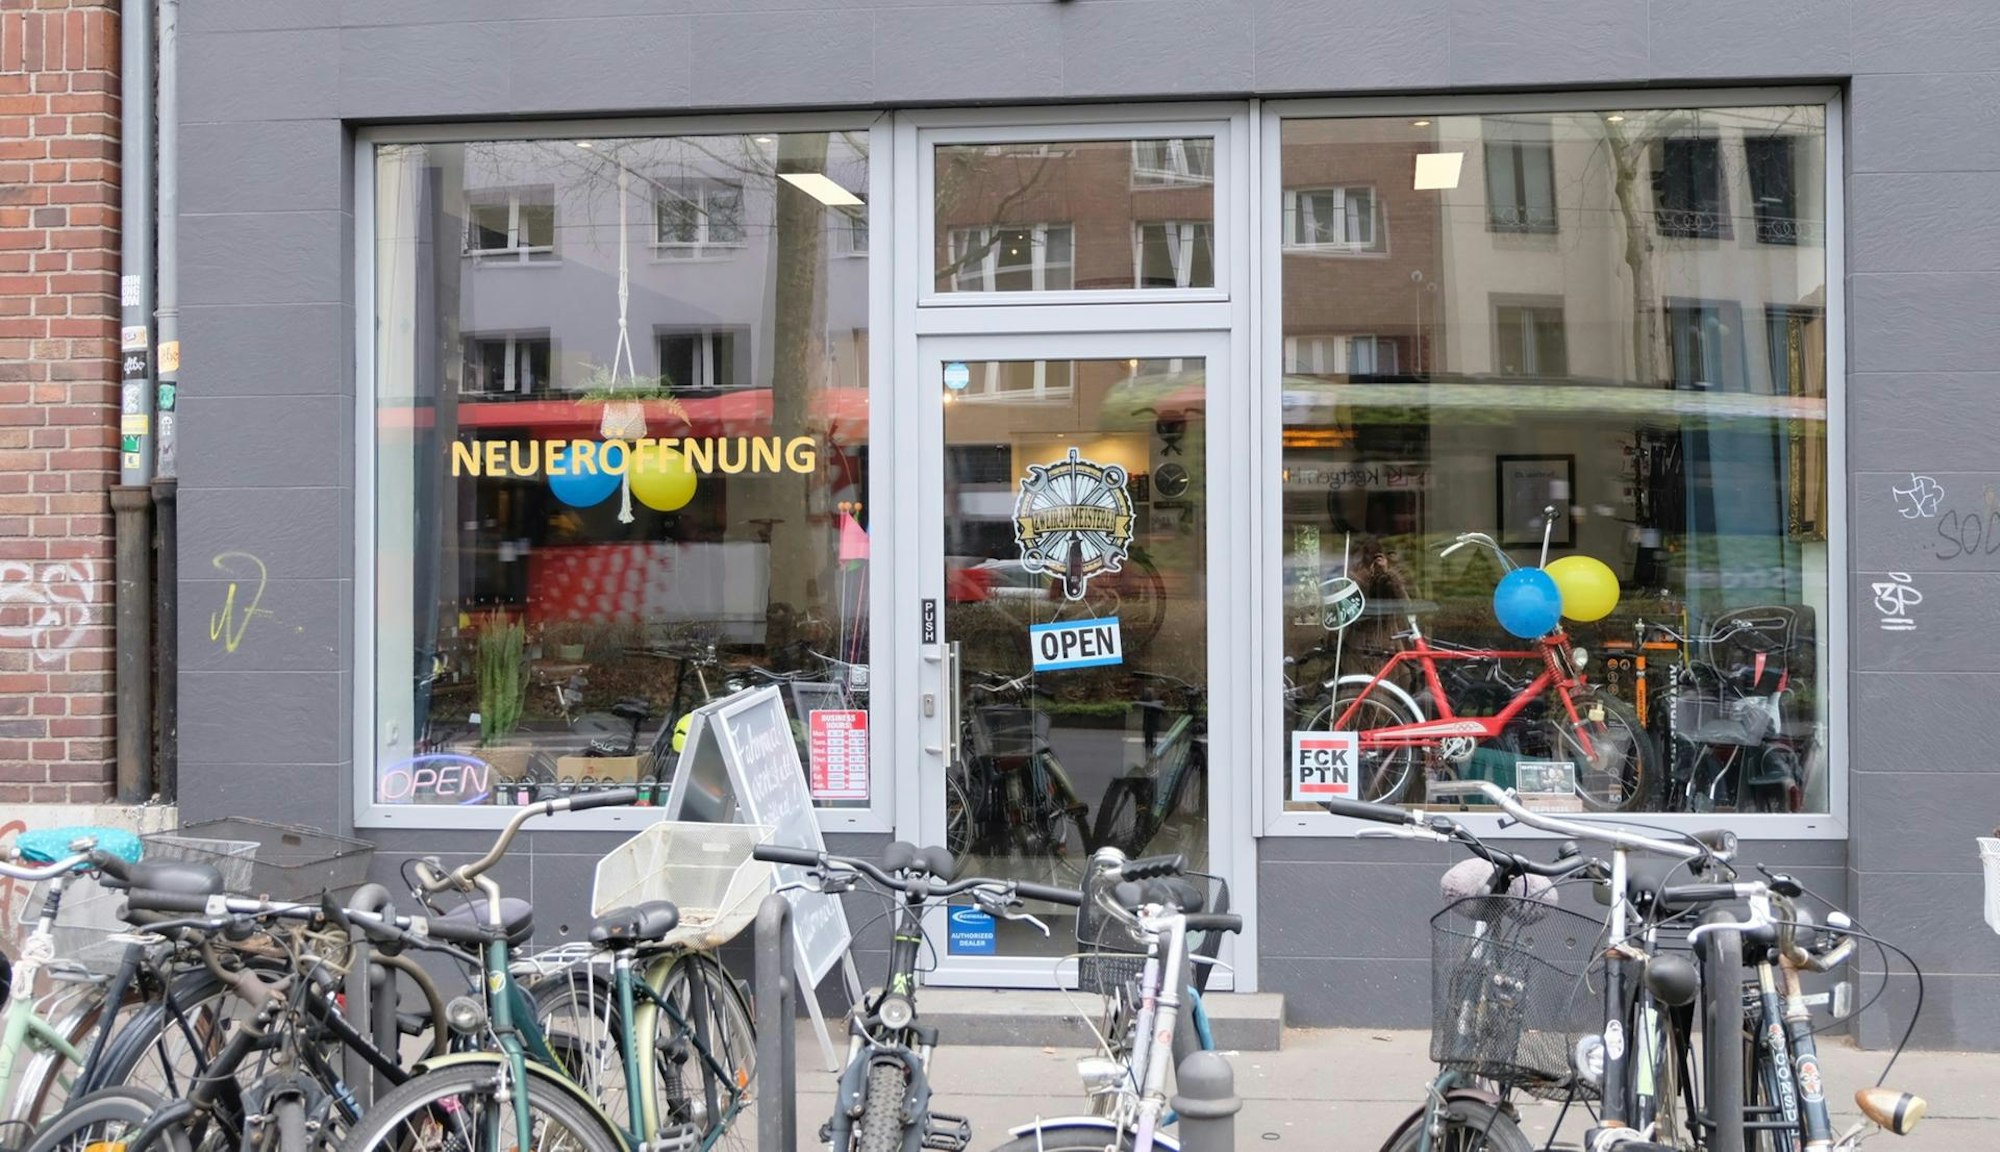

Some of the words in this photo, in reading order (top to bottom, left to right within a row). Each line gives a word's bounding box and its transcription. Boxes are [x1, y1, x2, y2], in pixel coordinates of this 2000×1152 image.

[452, 427, 816, 477] NEUERÖFFNUNG
[1034, 507, 1115, 530] ZWEIRADMEISTEREI
[925, 602, 934, 641] PUSH
[1040, 626, 1115, 661] OPEN
[1300, 749, 1349, 766] FCK
[382, 765, 489, 799] OPEN
[1300, 767, 1349, 783] PTN
[951, 932, 994, 940] AUTHORIZED
[959, 939, 986, 947] DEALER
